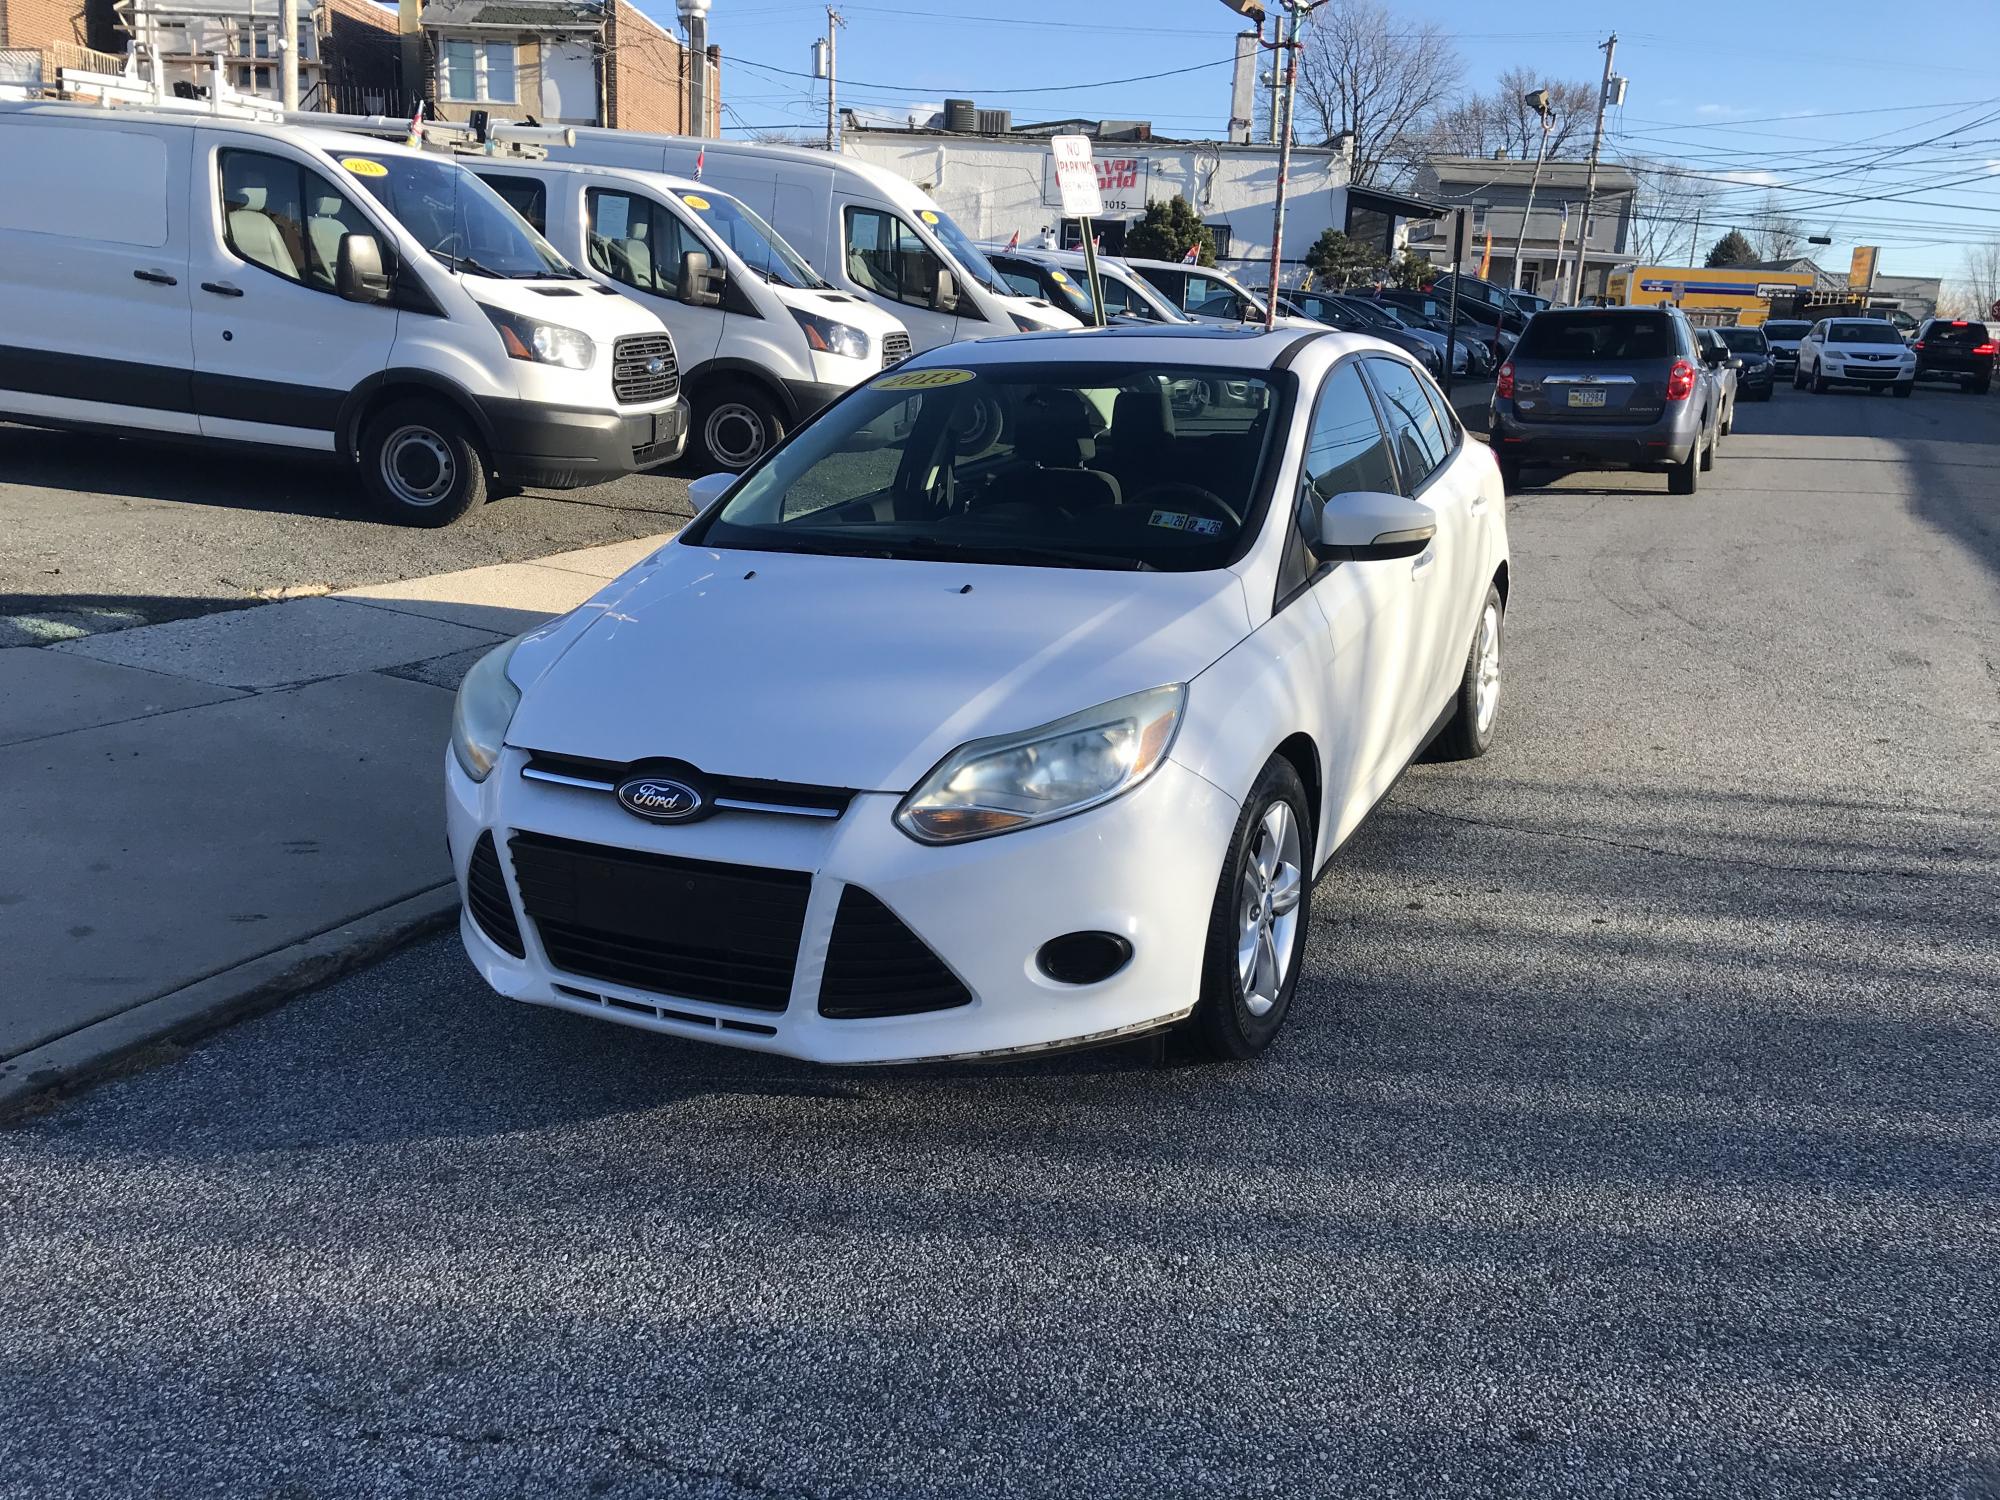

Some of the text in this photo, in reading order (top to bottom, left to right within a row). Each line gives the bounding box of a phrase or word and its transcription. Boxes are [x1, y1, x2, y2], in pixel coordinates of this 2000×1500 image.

[1066, 142, 1080, 156] NO
[1060, 161, 1093, 175] PARKING
[1104, 159, 1138, 175] Van
[880, 371, 961, 388] 2013
[633, 783, 680, 809] Ford
